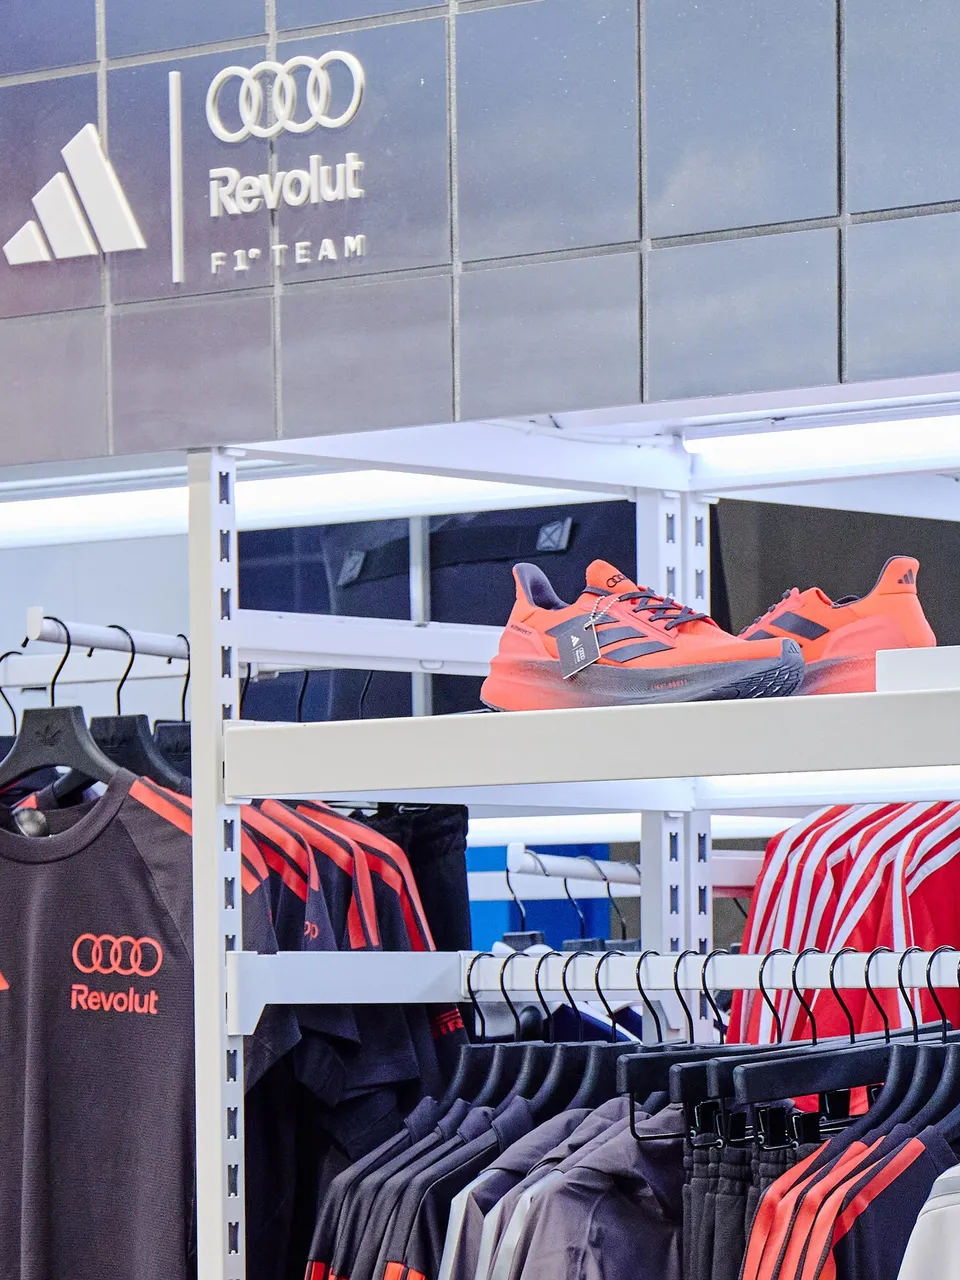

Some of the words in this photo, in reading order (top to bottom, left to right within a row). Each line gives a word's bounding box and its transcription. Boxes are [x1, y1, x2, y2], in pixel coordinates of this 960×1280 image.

[209, 152, 364, 217] Revolut
[272, 234, 366, 266] TEAM
[71, 984, 158, 1014] Revolut
